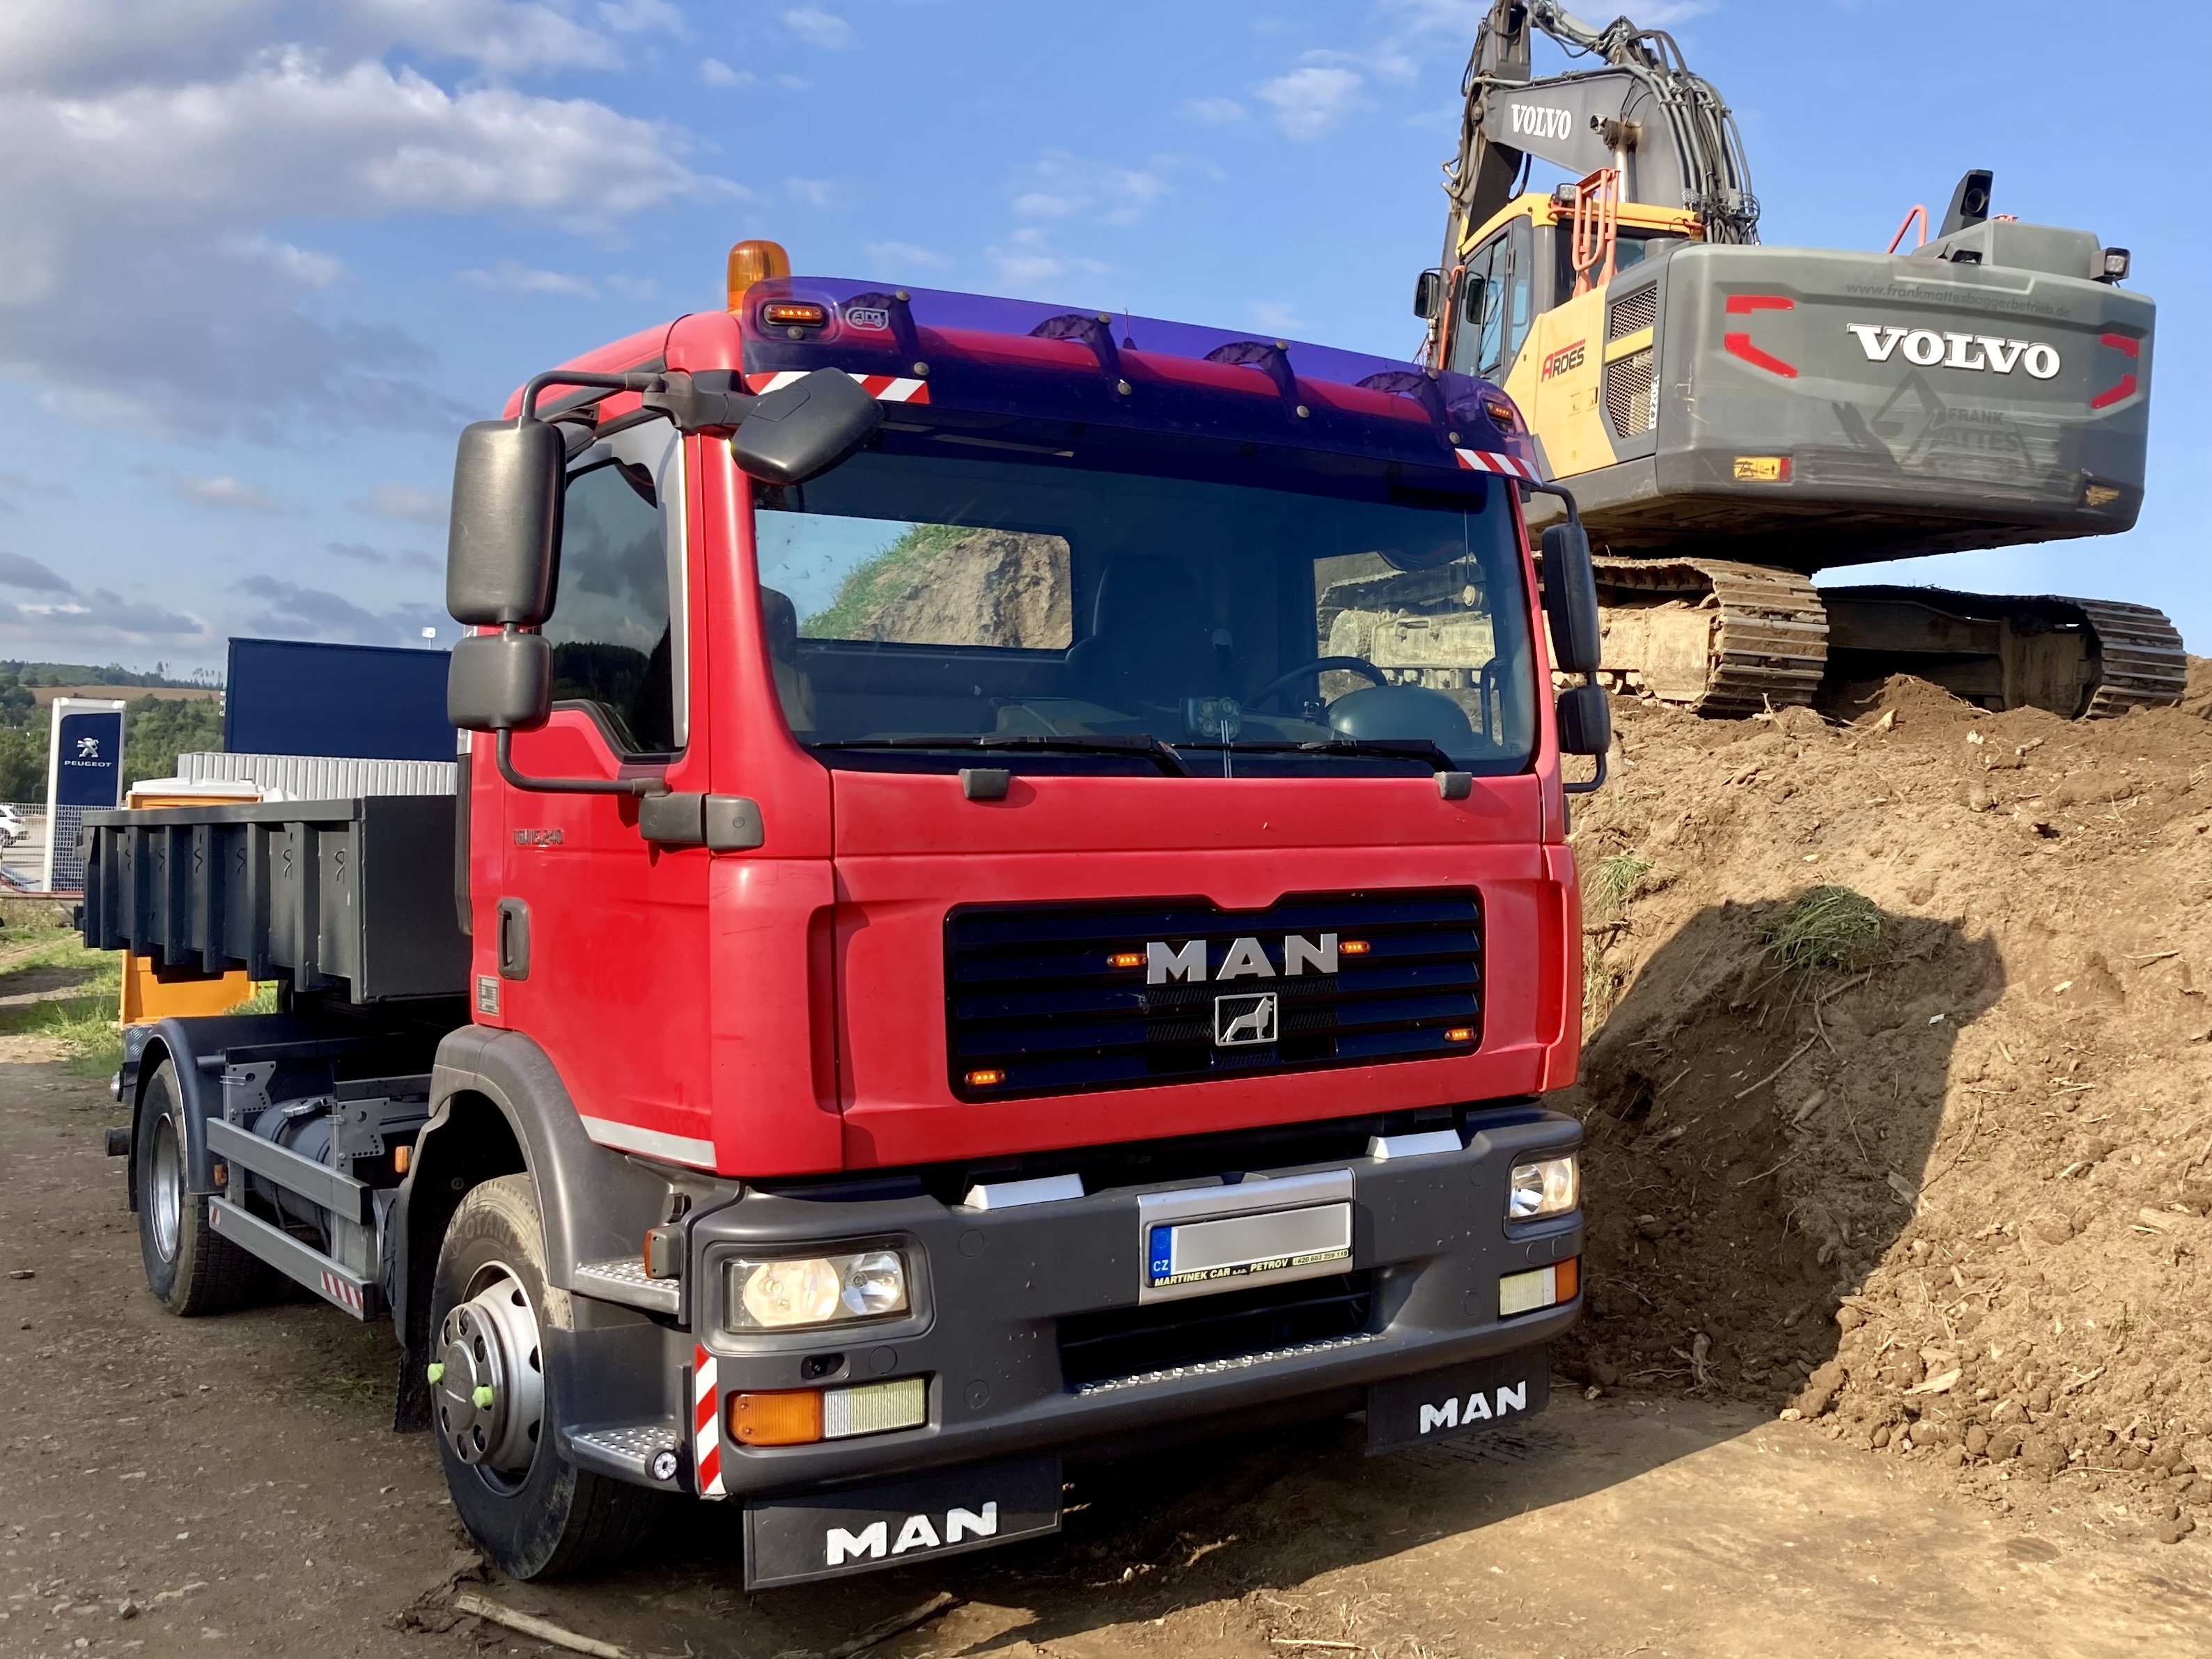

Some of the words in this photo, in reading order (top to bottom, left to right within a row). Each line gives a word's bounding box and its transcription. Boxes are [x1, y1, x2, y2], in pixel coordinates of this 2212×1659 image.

[1511, 104, 1572, 140] VOLVO
[1846, 283, 2071, 318] www.frankmattesbaggerbetrieb.de
[1847, 323, 2062, 379] VOLVO
[1947, 407, 2004, 426] FRANK
[1146, 933, 1338, 984] MAN
[1153, 1259, 1169, 1272] CZ
[1154, 1271, 1208, 1287] MARTINEK
[1209, 1268, 1231, 1279] CAR
[1250, 1259, 1288, 1272] PETROV
[1419, 1380, 1526, 1434] MAN
[827, 1501, 997, 1566] MAN
